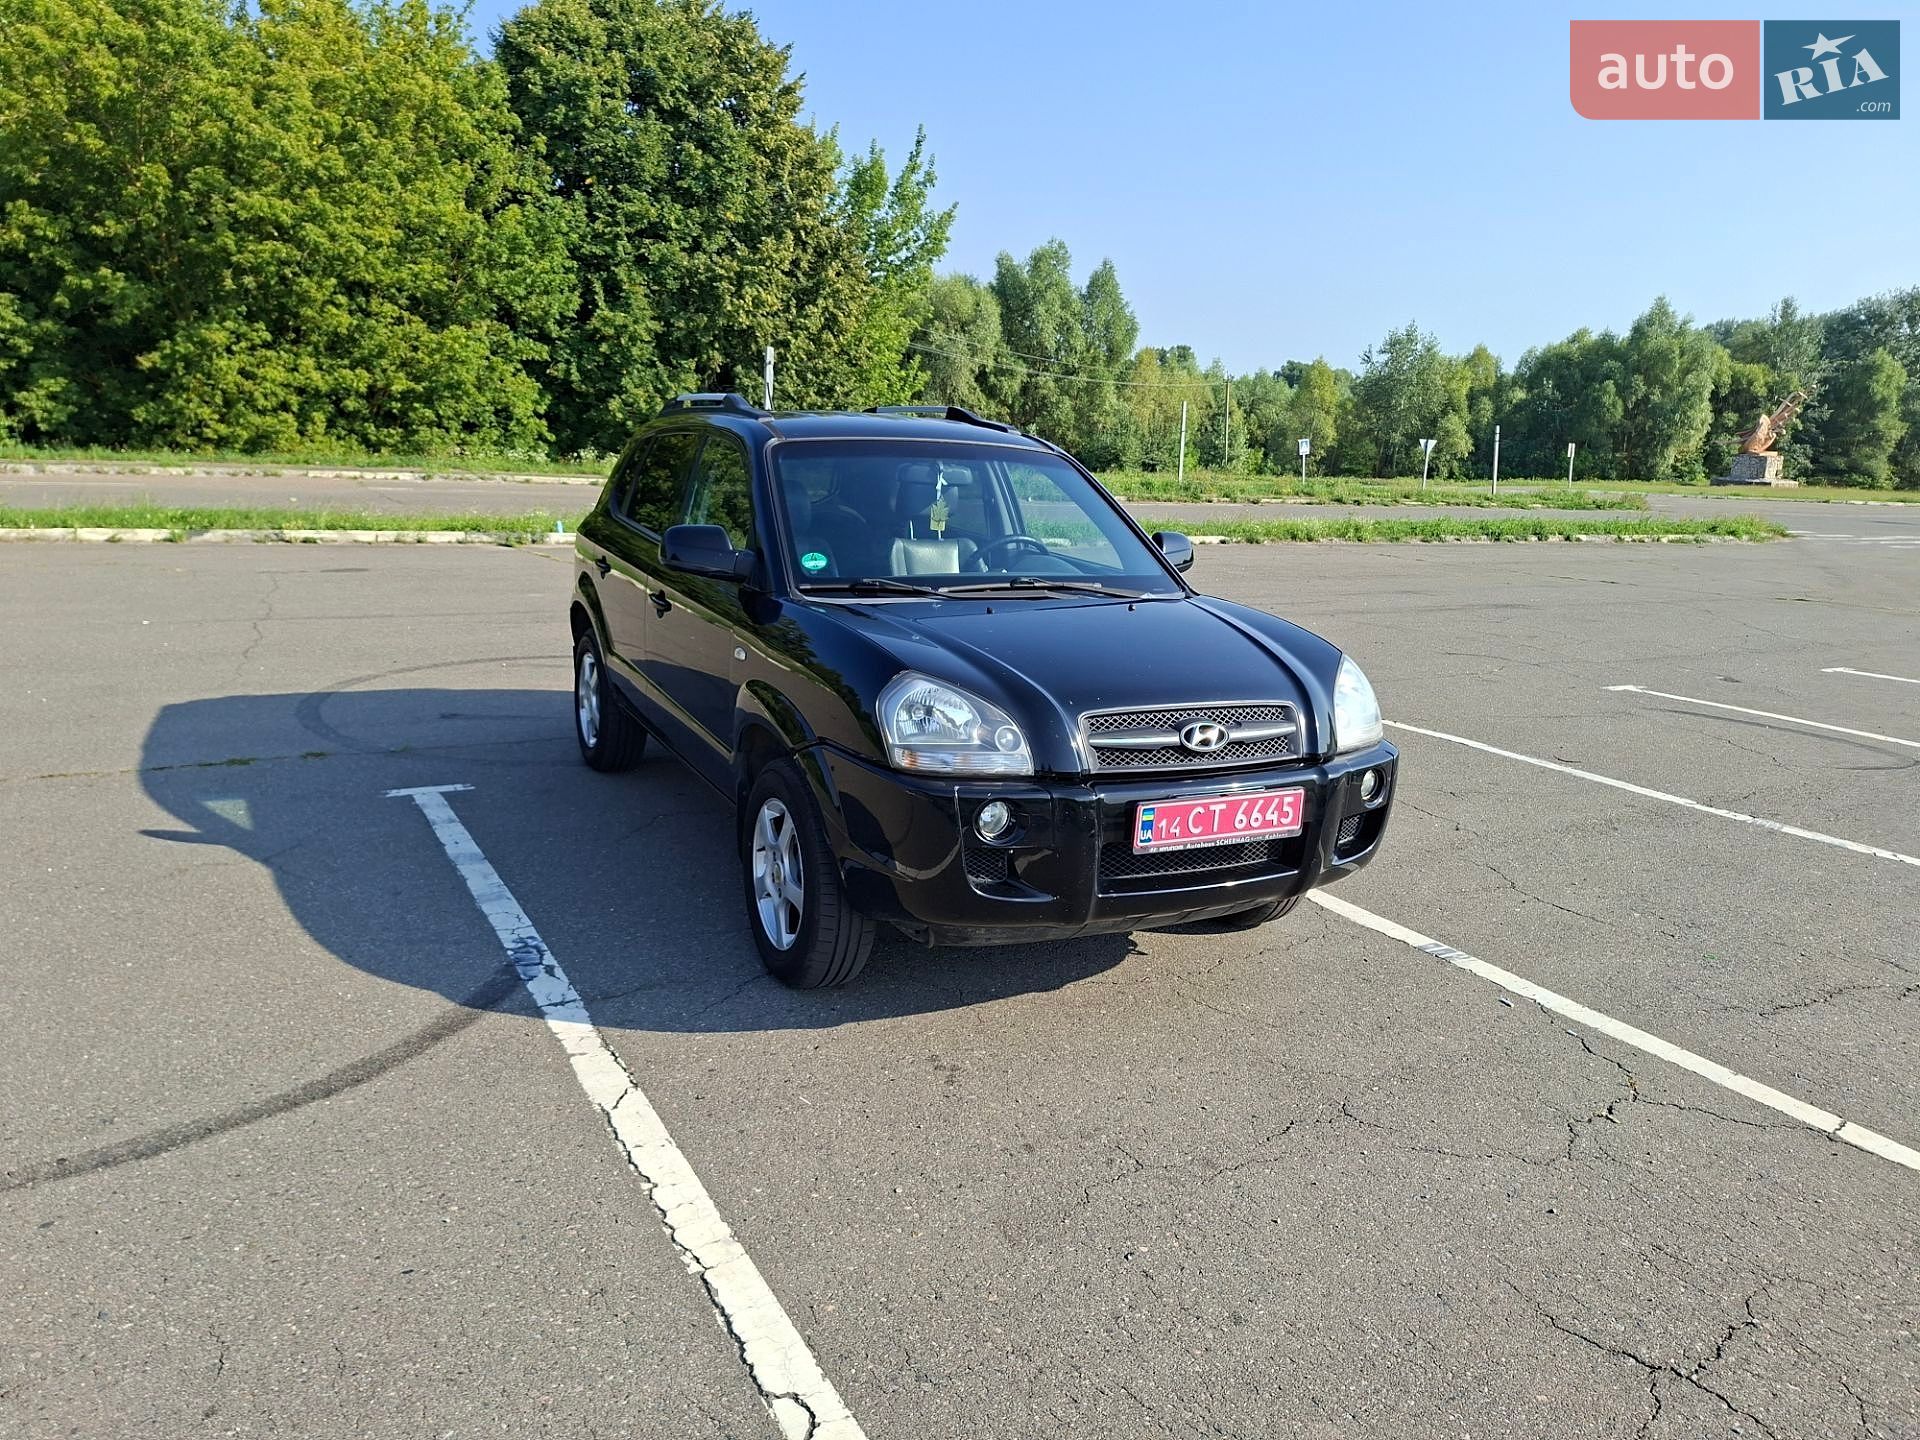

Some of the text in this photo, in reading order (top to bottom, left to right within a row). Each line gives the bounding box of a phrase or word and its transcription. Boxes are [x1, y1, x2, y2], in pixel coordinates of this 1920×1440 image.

[1158, 796, 1294, 839] 14 CT 6645
[1140, 830, 1152, 840] UA
